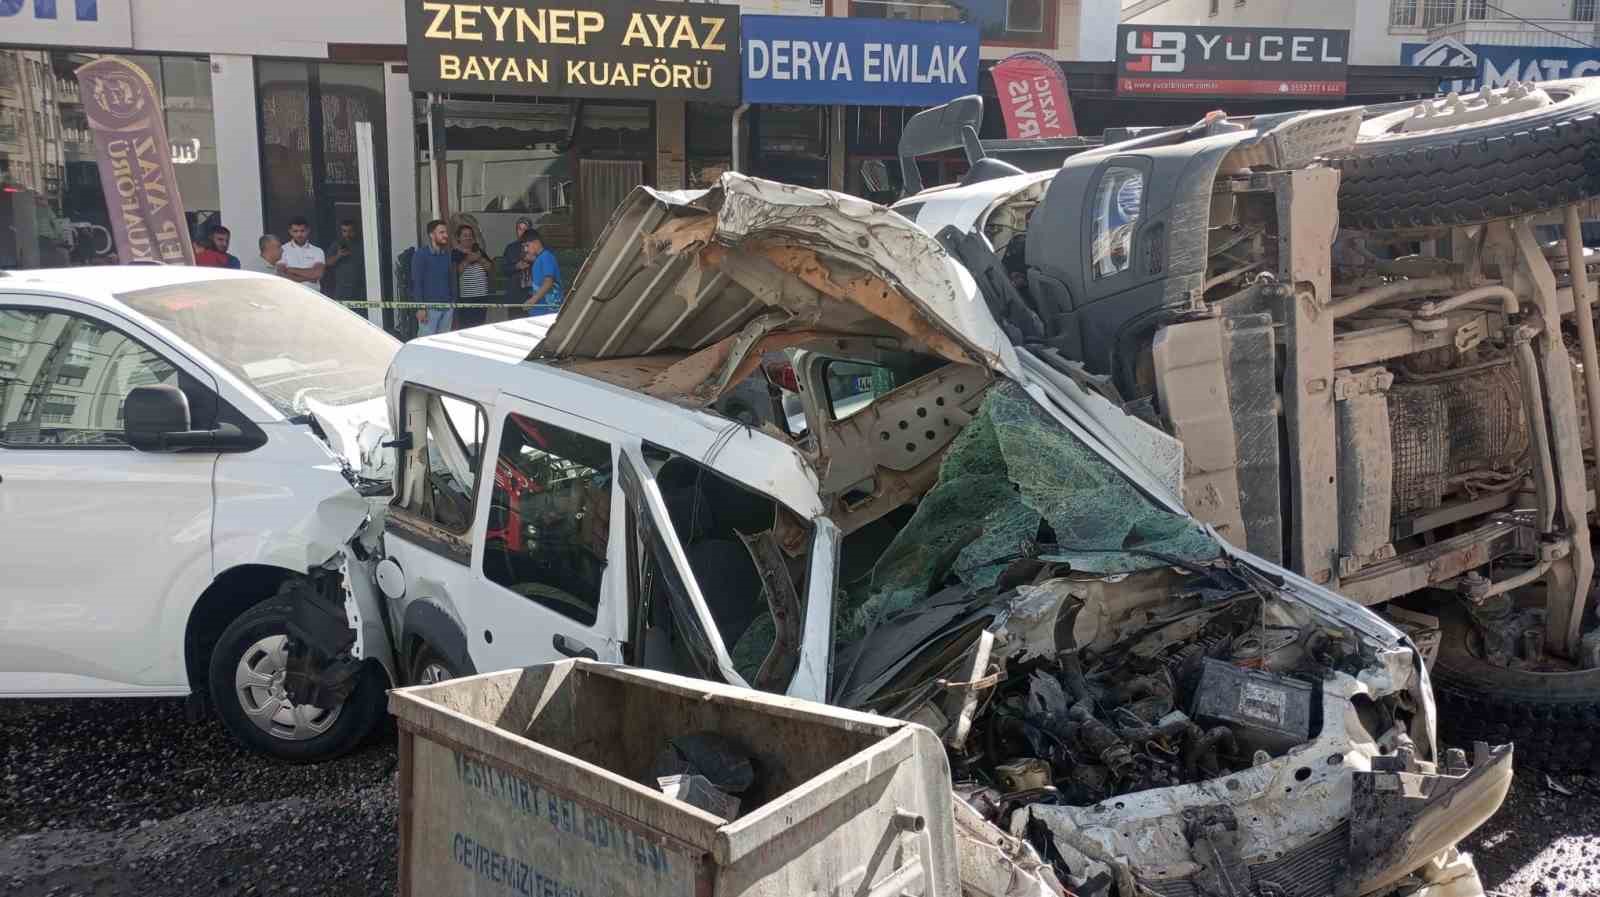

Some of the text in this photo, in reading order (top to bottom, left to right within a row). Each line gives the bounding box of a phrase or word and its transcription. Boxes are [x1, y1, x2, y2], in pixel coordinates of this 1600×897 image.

[423, 2, 726, 51] ZEYNEP AYAZ
[440, 54, 712, 90] BAYAN KUAFÖRÜ
[748, 39, 968, 84] DERYA EMLAK
